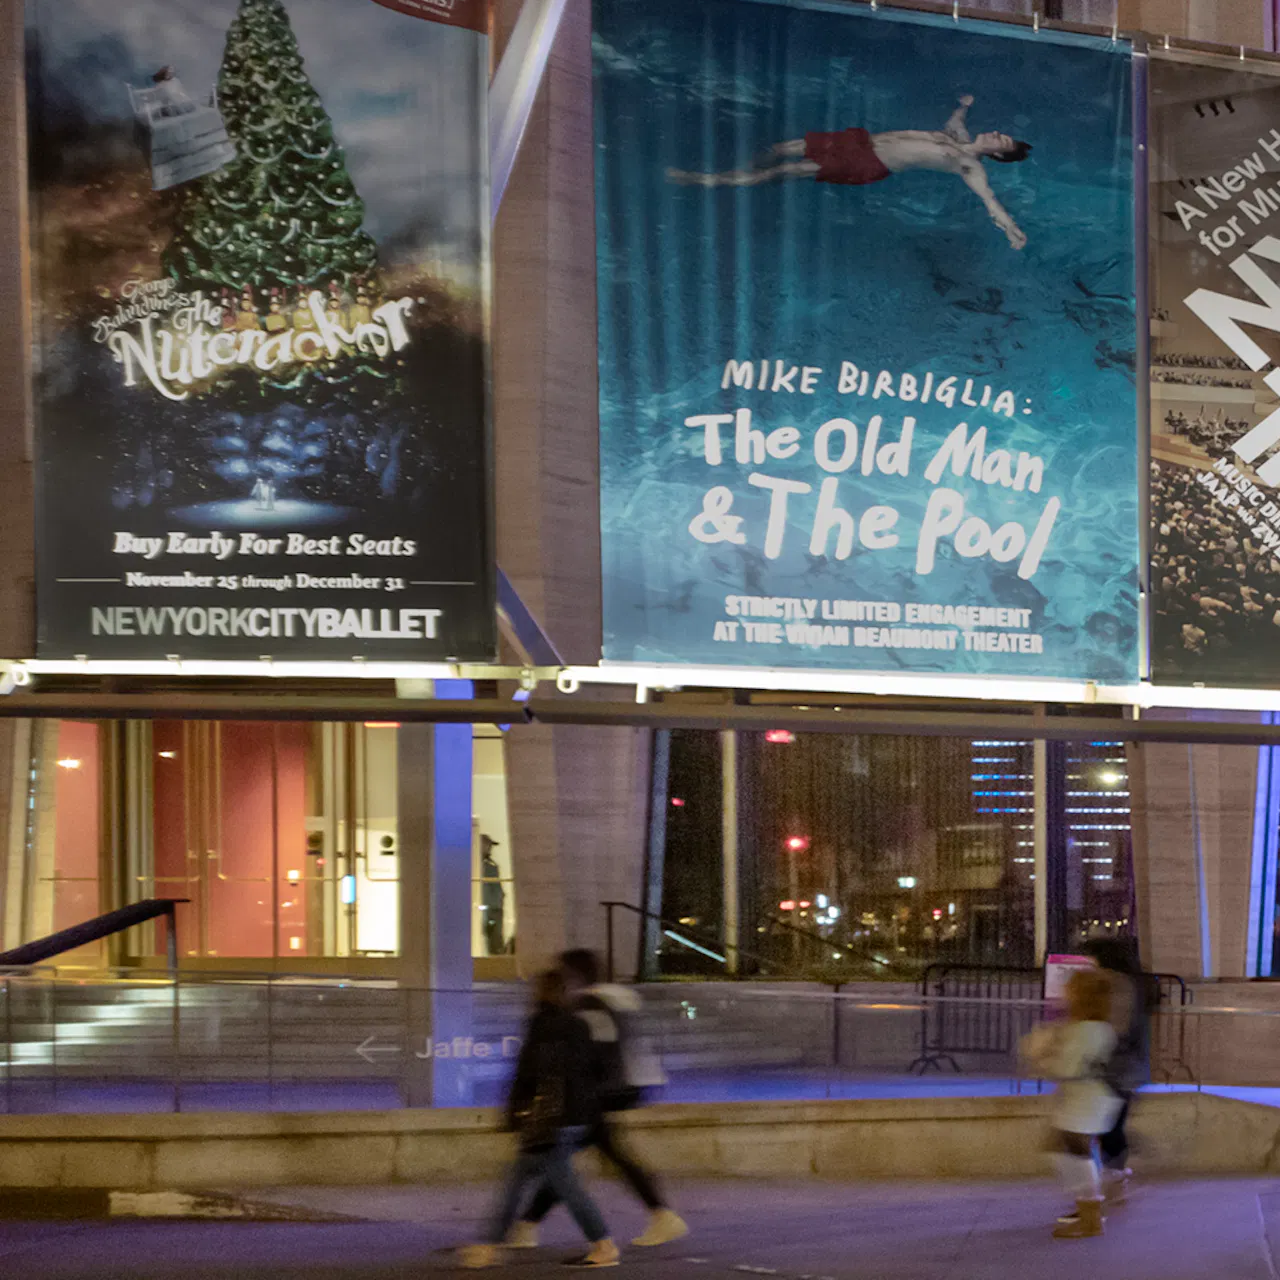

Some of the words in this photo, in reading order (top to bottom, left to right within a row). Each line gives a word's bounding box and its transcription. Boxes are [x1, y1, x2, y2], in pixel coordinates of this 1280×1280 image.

[1174, 200, 1207, 231] A
[1194, 152, 1266, 210] New
[1198, 215, 1246, 256] for
[173, 290, 222, 333] The
[109, 290, 415, 401] Nutcracker
[721, 359, 823, 395] MIKE
[837, 361, 1033, 418] BIRBIGLIA:
[684, 408, 800, 466] The
[814, 415, 917, 477] Old
[923, 421, 1046, 494] Man
[1196, 471, 1240, 507] JAAP
[1212, 457, 1266, 507] MUSIC
[113, 531, 163, 559] Buy
[166, 531, 237, 560] Early
[238, 532, 283, 556] For
[286, 533, 342, 556] Best
[346, 533, 417, 557] Seats
[688, 485, 747, 545] &
[748, 472, 900, 561] The
[915, 488, 1061, 580] Pool
[125, 572, 214, 588] November
[217, 576, 238, 590] 25
[242, 575, 293, 591] through
[296, 573, 380, 589] December
[385, 576, 405, 592] 31
[91, 606, 444, 639] NEWYORKCITYBALLET
[725, 595, 818, 620] STRICTLY
[821, 599, 902, 624] LIMITED
[905, 602, 1032, 629] ENGAGEMENT
[713, 620, 739, 643] AT
[744, 621, 784, 645] THE
[786, 623, 850, 648] VIVIAN
[854, 625, 959, 651] BEAUMONT
[963, 629, 1043, 655] THEATER
[415, 1036, 489, 1059] Jaffe
